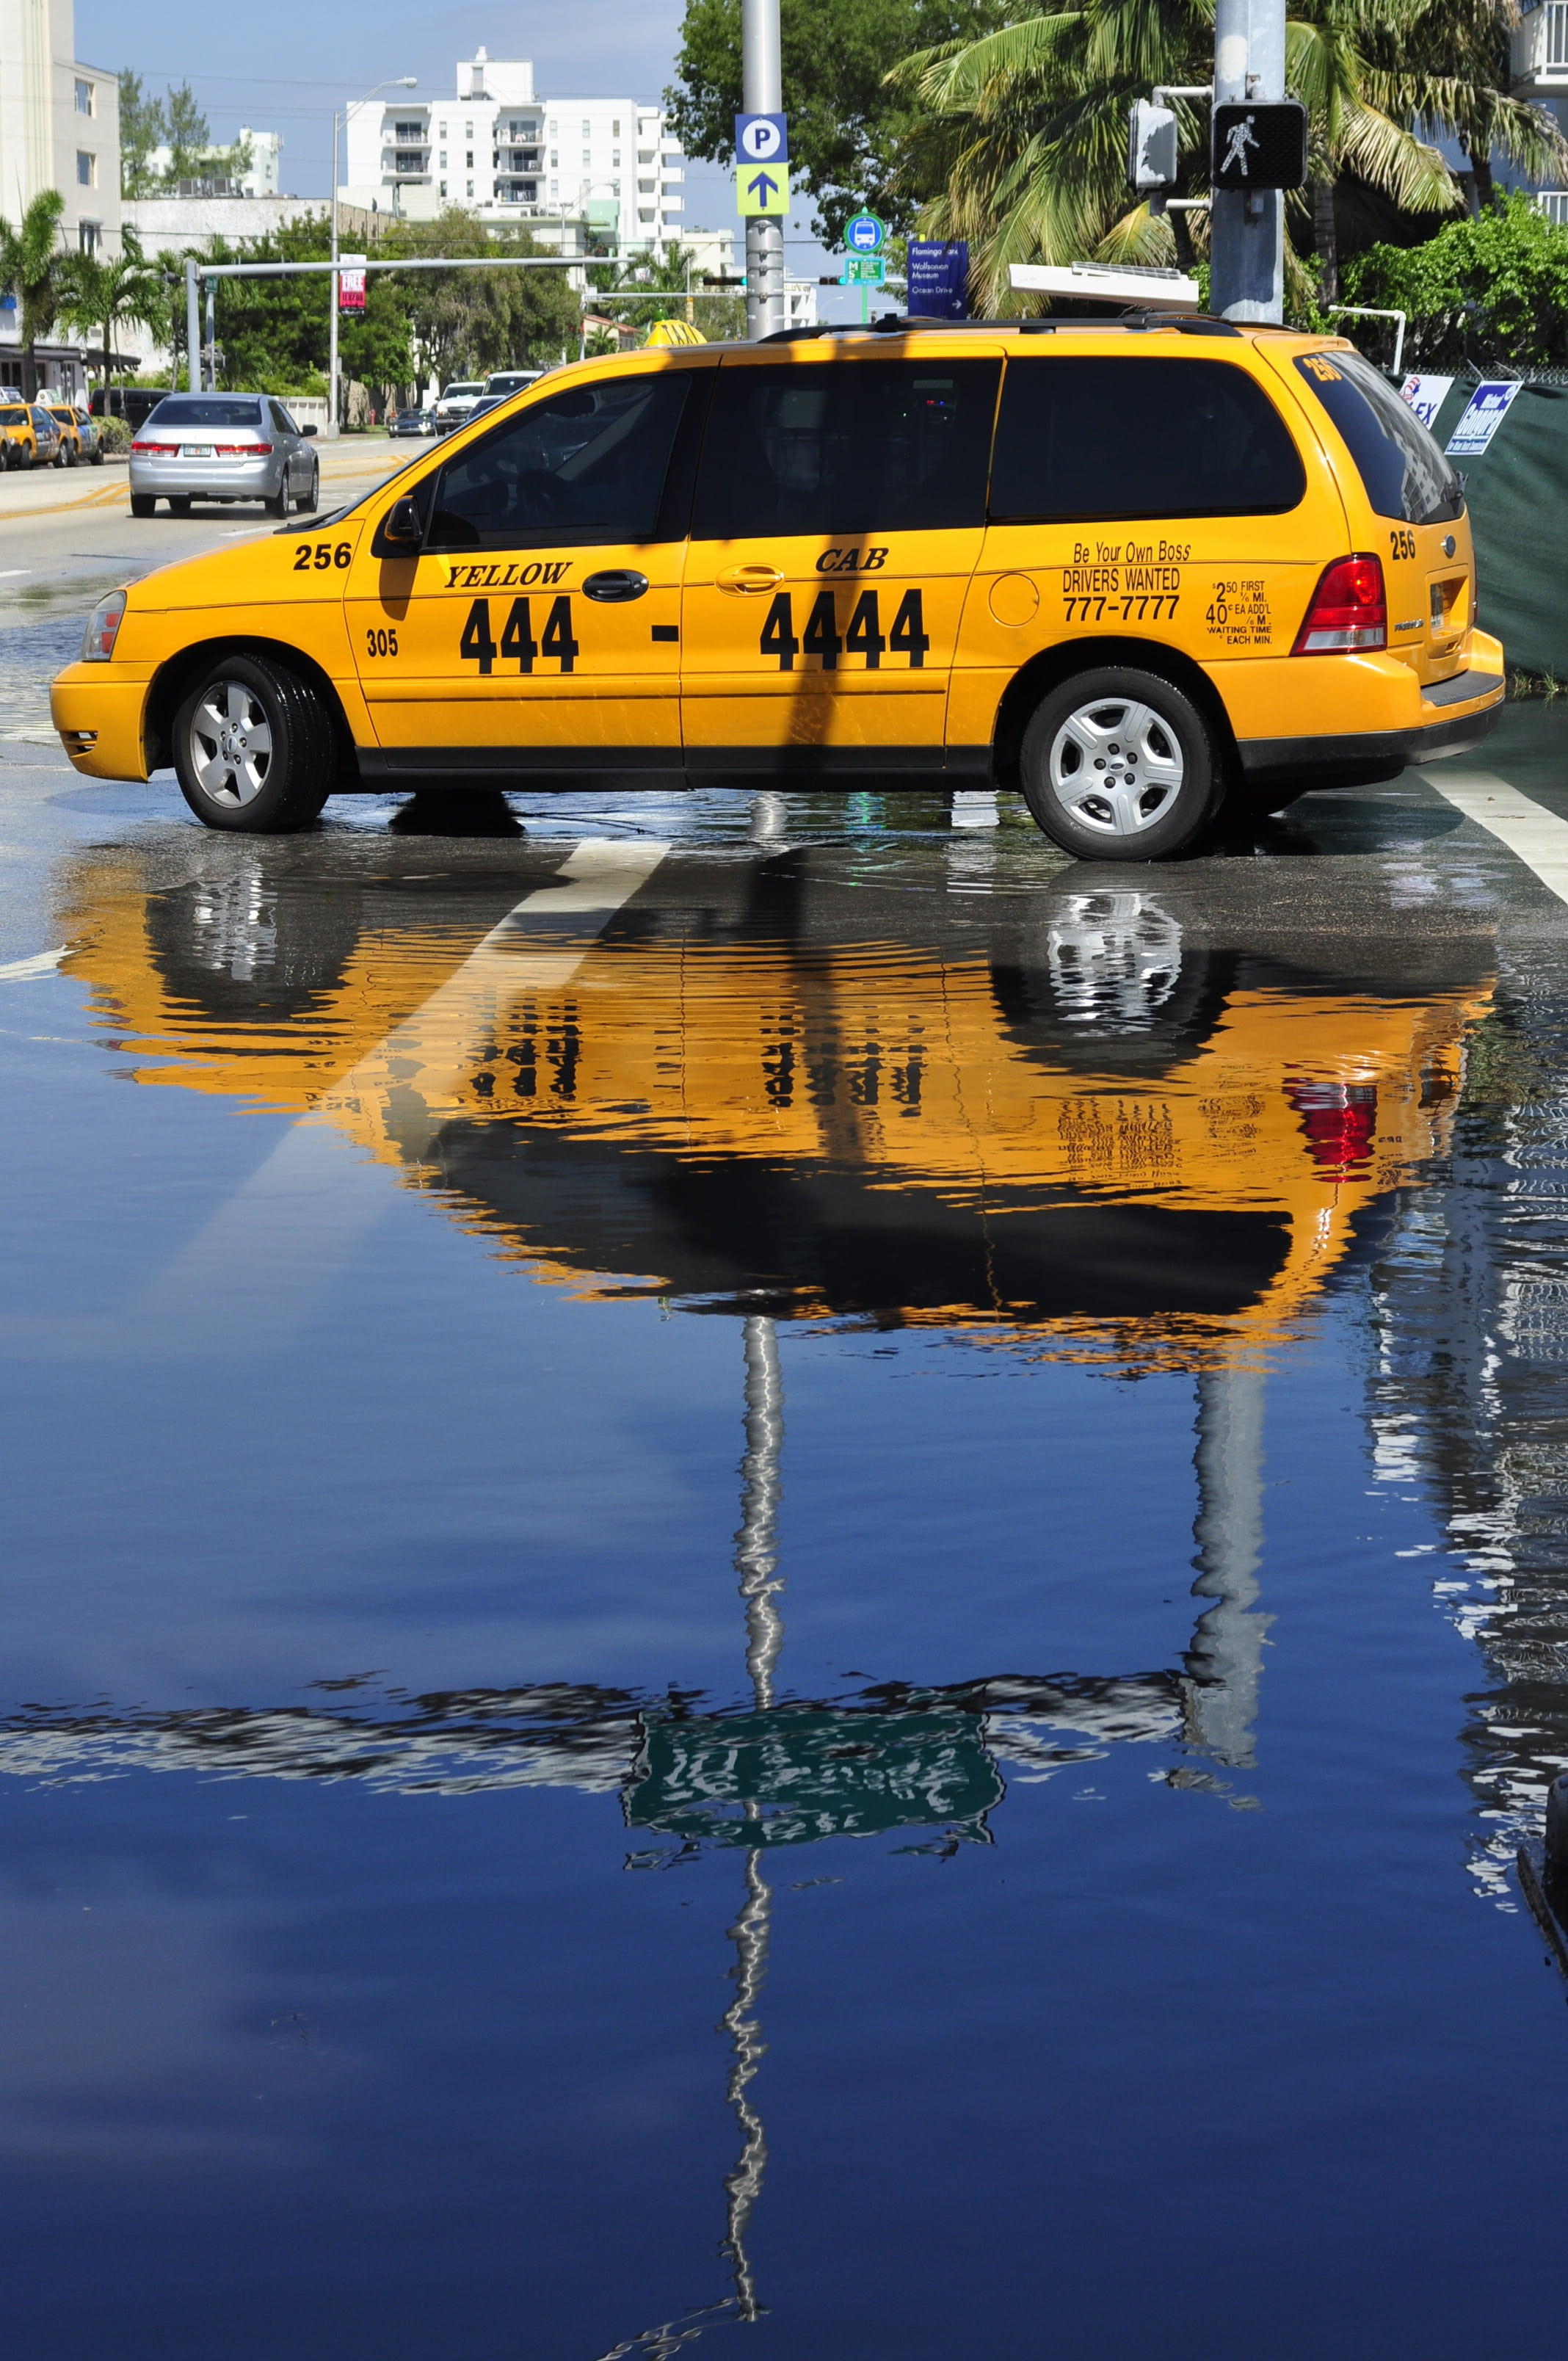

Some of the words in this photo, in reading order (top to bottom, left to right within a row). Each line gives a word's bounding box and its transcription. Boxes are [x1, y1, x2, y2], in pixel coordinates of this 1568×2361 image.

[755, 128, 771, 150] P
[912, 247, 942, 258] Flamingo
[912, 261, 949, 270] Wolfsonian
[912, 286, 934, 294] Ocean
[936, 286, 953, 294] Drive
[661, 324, 699, 344] TAXI
[1303, 358, 1343, 381] 256
[293, 542, 352, 570] 256
[1074, 543, 1089, 564] Be
[1096, 541, 1121, 562] Your
[1126, 541, 1153, 563] Own
[1158, 540, 1191, 562] Boss
[1390, 529, 1415, 561] 256
[816, 547, 889, 573] CAB
[444, 562, 573, 588] YELLOW
[1063, 568, 1119, 593] DRIVERS
[1125, 567, 1180, 591] WANTED
[1241, 580, 1265, 591] FIRST
[1063, 595, 1180, 622] 777-7777
[1235, 603, 1246, 614] EA
[1248, 603, 1271, 614] ADD'L
[1252, 592, 1267, 602] MI.
[460, 595, 578, 674] 444
[759, 589, 929, 670] 4444
[1227, 635, 1251, 645] EACH
[1254, 635, 1273, 645] MIN.
[1250, 625, 1272, 634] TIME
[366, 628, 399, 657] 305
